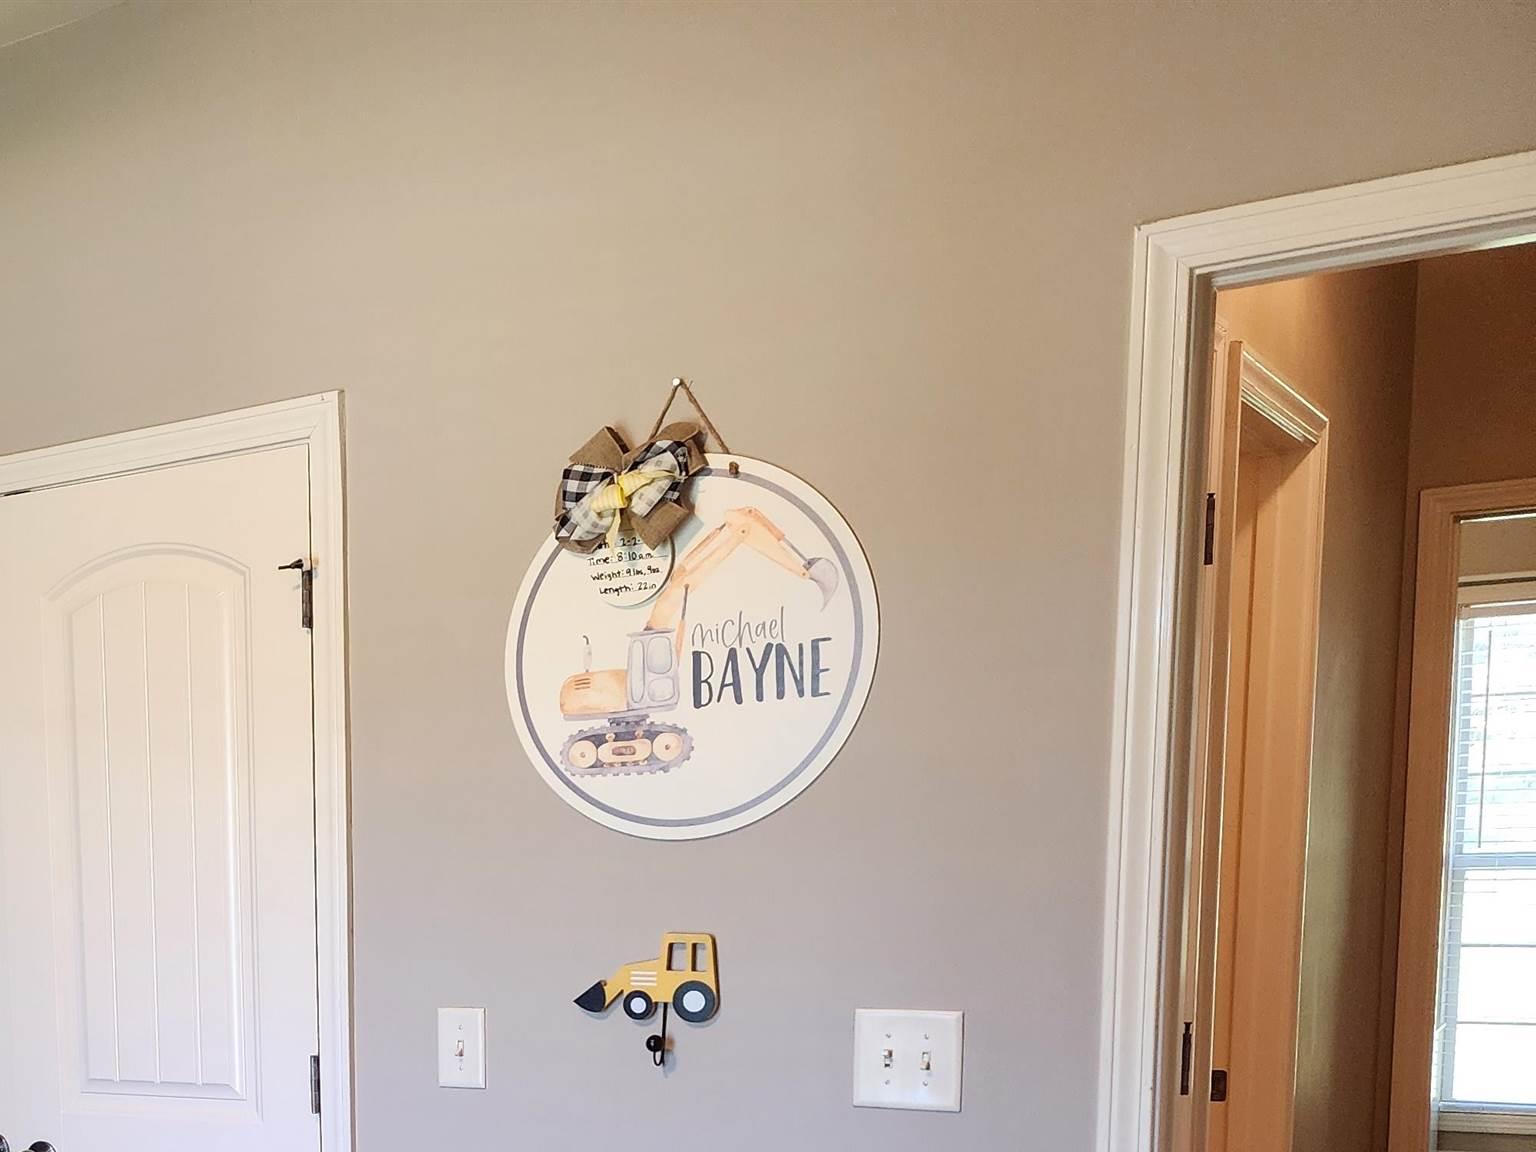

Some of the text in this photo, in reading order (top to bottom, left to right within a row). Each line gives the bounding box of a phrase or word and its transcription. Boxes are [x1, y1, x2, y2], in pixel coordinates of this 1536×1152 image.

[587, 556, 613, 566] Time:
[591, 570, 625, 581] Weight:
[599, 583, 634, 596] Length:
[692, 637, 832, 709] BAYNE
